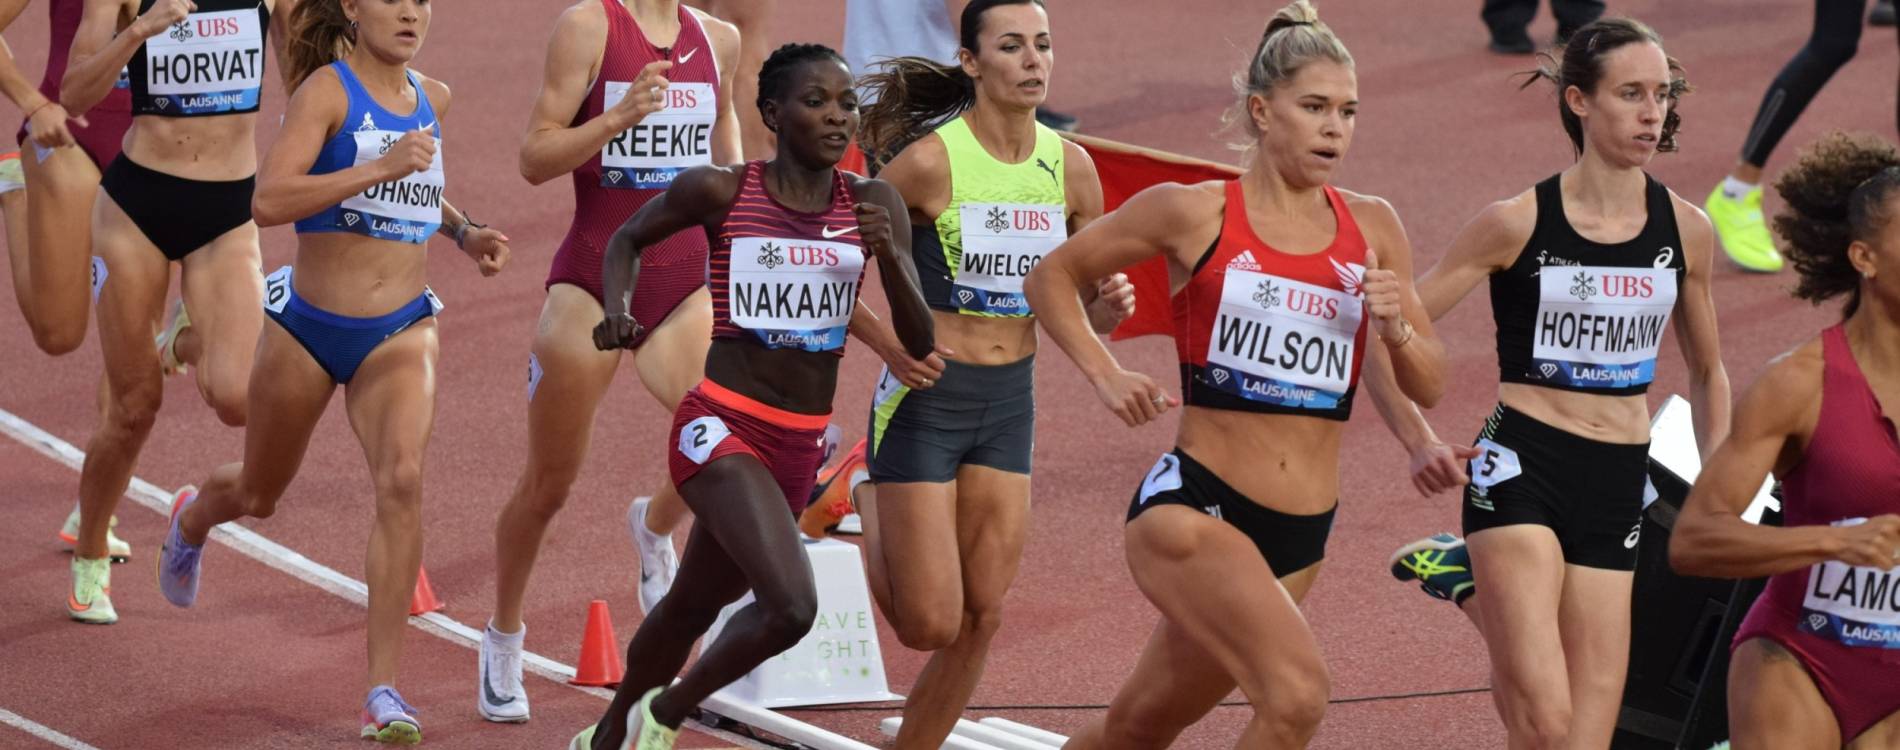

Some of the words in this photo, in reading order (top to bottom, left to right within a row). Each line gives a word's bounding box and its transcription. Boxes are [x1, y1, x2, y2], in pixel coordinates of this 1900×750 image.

[196, 16, 239, 38] UBS
[152, 48, 259, 85] HORVAT
[181, 94, 243, 108] LAUSANNE
[607, 123, 710, 157] REEKIE
[636, 171, 677, 183] LAUSA
[363, 180, 442, 209] OHNSON
[371, 219, 425, 237] LAUSANNE
[1012, 210, 1051, 231] UBS
[787, 245, 840, 267] UBS
[1226, 262, 1262, 271] adidas
[1602, 275, 1654, 299] UBS
[735, 282, 853, 319] NAKAAYI
[1286, 287, 1339, 321] UBS
[768, 333, 830, 346] LAUSANNE
[1540, 311, 1665, 353] HOFFMANN
[1218, 314, 1348, 381] WILSON
[1572, 366, 1640, 381] LAUSANNE
[1242, 377, 1316, 401] LAUSANNE
[692, 423, 708, 449] 2
[1481, 449, 1500, 477] 5
